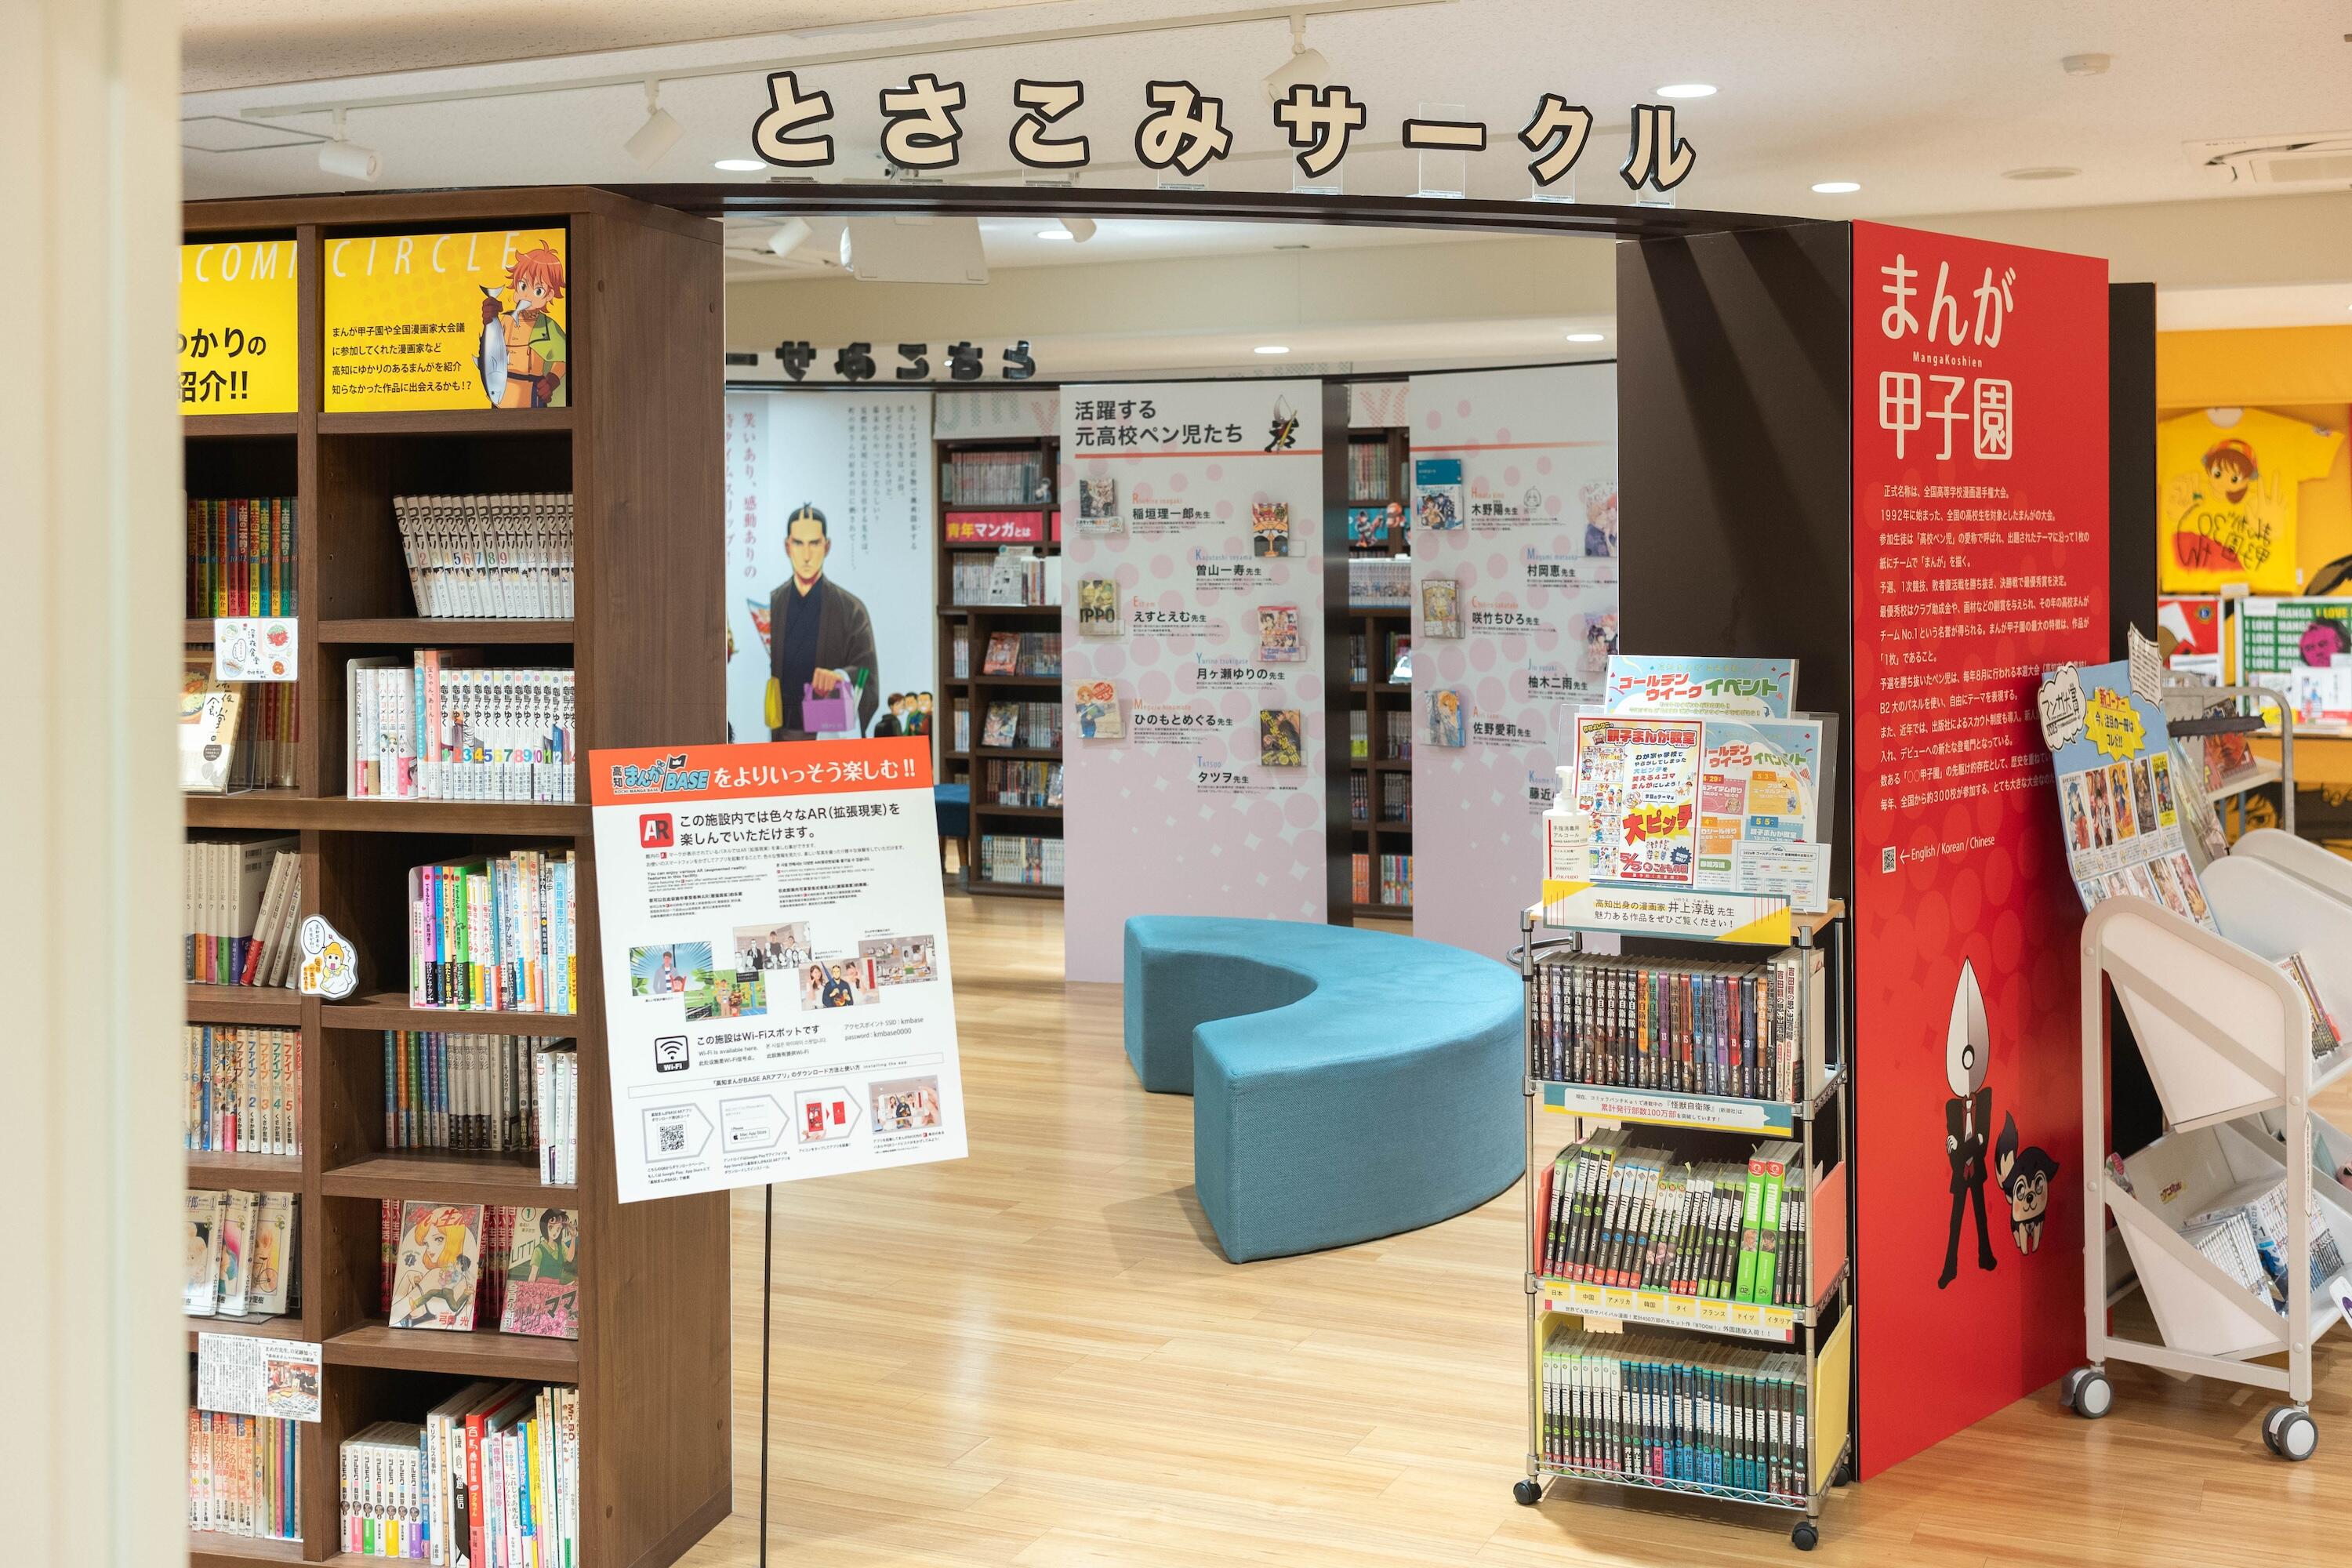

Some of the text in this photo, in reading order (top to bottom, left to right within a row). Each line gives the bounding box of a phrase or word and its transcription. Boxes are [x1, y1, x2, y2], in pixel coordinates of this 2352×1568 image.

[753, 71, 1696, 191] とさこみサークル
[177, 232, 519, 283] COMI CIRCLE
[1882, 254, 2016, 348] まんが
[332, 322, 465, 337] まんが甲子園や全国漫画家大会議
[332, 342, 442, 357] に参加してくれた漫画家など
[1913, 351, 1982, 368] MangaKoshien
[332, 361, 462, 376] 高知にゆかりのあるまんがを紹介
[1076, 400, 1156, 421] 活躍する
[1879, 371, 2013, 460] 甲子園
[1076, 423, 1243, 446] 元高校ペン児たち
[743, 412, 757, 579] 笑いあり、感動ありの
[1133, 508, 1210, 521] 稲垣理一郎先生
[406, 552, 412, 564] 1
[419, 553, 427, 565] 2
[453, 553, 461, 565] 5
[463, 553, 470, 565] 6
[474, 552, 481, 564] 7
[488, 552, 495, 564] 8
[499, 552, 507, 564] 9
[1879, 555, 1971, 570] 紙にチームで「まんが」を描く。
[1134, 611, 1207, 622] えすとえむ先生
[2278, 608, 2349, 619] MANGA LOVE
[1619, 673, 1689, 689] ゴールデン
[1705, 679, 1778, 696] イベント
[1646, 686, 1702, 701] ウイーク
[1134, 714, 1232, 726] ひのもとめぐる先生
[1880, 709, 2039, 738] また、近年では、出版社によるスカウト制度も導入。新人
[463, 749, 472, 761] 3
[474, 749, 484, 761] 4
[485, 749, 493, 761] 5
[504, 749, 514, 762] 7
[523, 749, 532, 762] 9
[1705, 745, 1750, 757] ールデン
[1710, 756, 1752, 768] ウイーク
[612, 766, 622, 787] 高知
[625, 760, 665, 787] まんが
[665, 770, 710, 791] BASE
[714, 759, 915, 789] をよりいっそう楽しむ!!
[1530, 787, 1555, 801] 藤近
[681, 804, 900, 828] この施設内では色々なAR(拡張現実)を
[644, 819, 670, 841] AR
[1623, 804, 1692, 847] 大ピンチ
[681, 829, 815, 847] 楽しんでいただけます。
[1911, 836, 1995, 862] English Korean Chinese
[1595, 899, 1735, 916] 高知出身の漫画家 井上淳哉 先生
[1594, 910, 1733, 928] 魅力ある作品をぜひご覧ください!
[697, 1025, 819, 1045] この施設はWi-Fiスポットです
[844, 1028, 912, 1041] password kmbase0000
[249, 1041, 257, 1077] ファイブ
[274, 1043, 282, 1080] ファイブ
[285, 1044, 294, 1081] ファイブ
[249, 1097, 256, 1108] 2
[261, 1099, 269, 1110] 3
[274, 1098, 281, 1109] 4
[285, 1100, 293, 1111] 5
[1607, 1297, 1631, 1305] アメリカ
[1703, 1308, 1726, 1317] フランス
[1737, 1312, 1755, 1321] ドイツ
[1768, 1316, 1791, 1325] イタリア
